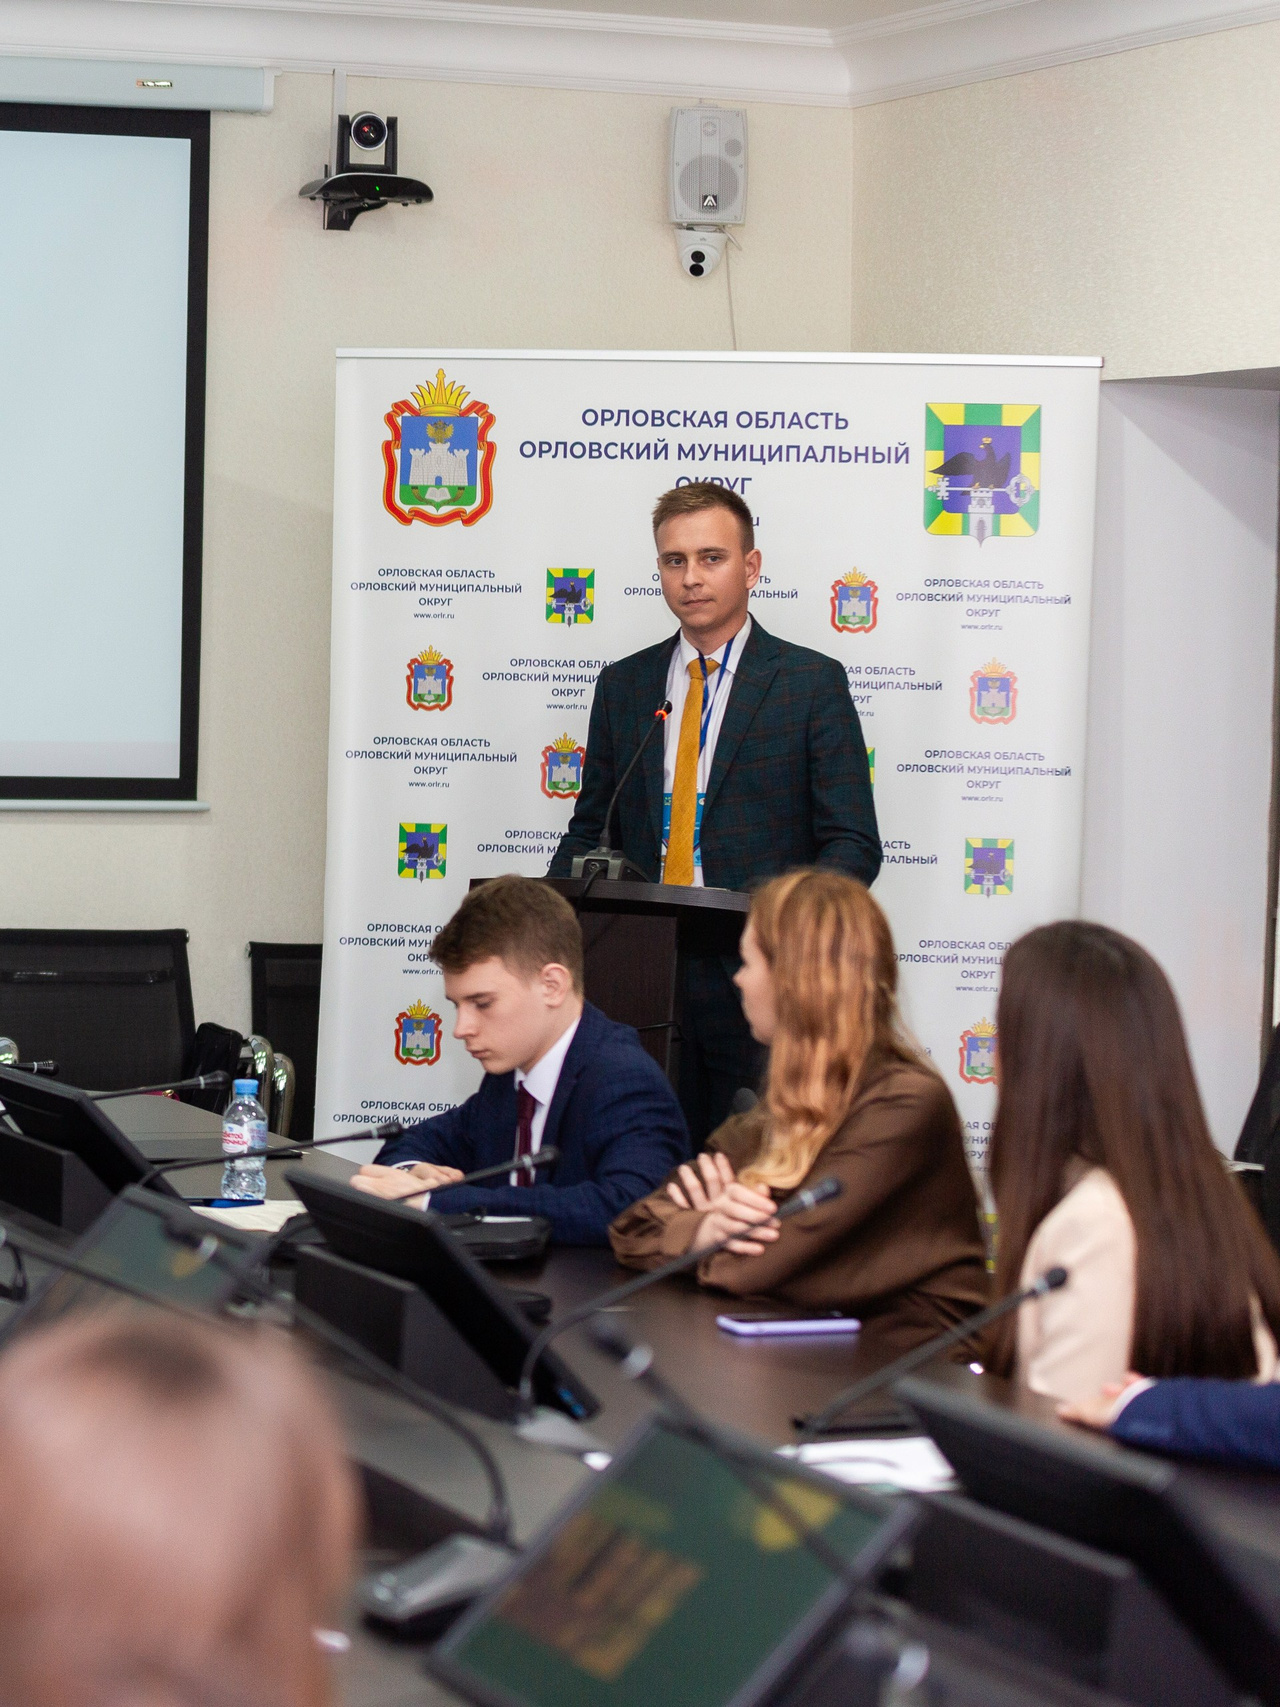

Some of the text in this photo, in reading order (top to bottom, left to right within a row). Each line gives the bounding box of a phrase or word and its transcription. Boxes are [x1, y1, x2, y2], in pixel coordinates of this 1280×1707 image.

[581, 409, 849, 430] ОРЛОВСКАЯ ОБЛАСТЬ
[519, 438, 910, 465] ОРЛОВСКИЙ МУНИЦИПАЛЬНЫЙ
[378, 568, 495, 578] ОРЛОВСКАЯ ОБЛАСТЬ
[351, 581, 522, 593] ОРЛОВСКИЙ МУНИЦИПАЛЬНЫЙ
[924, 579, 1044, 589] ОРЛОВСКАЯ ОБЛАСТЬ
[419, 598, 453, 606] ОКРУГ
[896, 592, 1072, 604] ОРЛОВСКИЙ МУНИЦИПАЛЬНЫЙ
[966, 609, 1000, 617] ОКРУГ
[510, 658, 575, 668] ОРЛОВСКАЯ
[865, 666, 915, 675] ОБЛАСТЬ
[482, 672, 549, 681] ОРЛОВСКИЙ
[848, 681, 942, 690] УНИЦИПАЛЬНЫЙ
[552, 688, 585, 697] ОКРУГ
[373, 737, 490, 747] ОРЛОВСКАЯ ОБЛАСТЬ
[346, 750, 517, 762] ОРЛОВСКИЙ МУНИЦИПАЛЬНЫЙ
[925, 750, 1045, 761] ОРЛОВСКАЯ ОБЛАСТЬ
[414, 766, 448, 775] ОКРУГ
[897, 764, 1072, 776] ОРЛОВСКИЙ МУНИЦИПАЛЬНЫЙ
[967, 780, 1001, 789] ОКРУГ
[505, 830, 563, 839] ОРЛОВСКА
[477, 844, 543, 853] ОРЛОВСКИЙ
[367, 923, 431, 933] ОРЛОВСКАЯ
[339, 937, 405, 947] ОРЛОВСКИЙ
[919, 940, 985, 950] ОРЛОВСКАЯ
[961, 970, 996, 979] ОКРУГ
[361, 1100, 425, 1111] ОРЛОВСКАЯ
